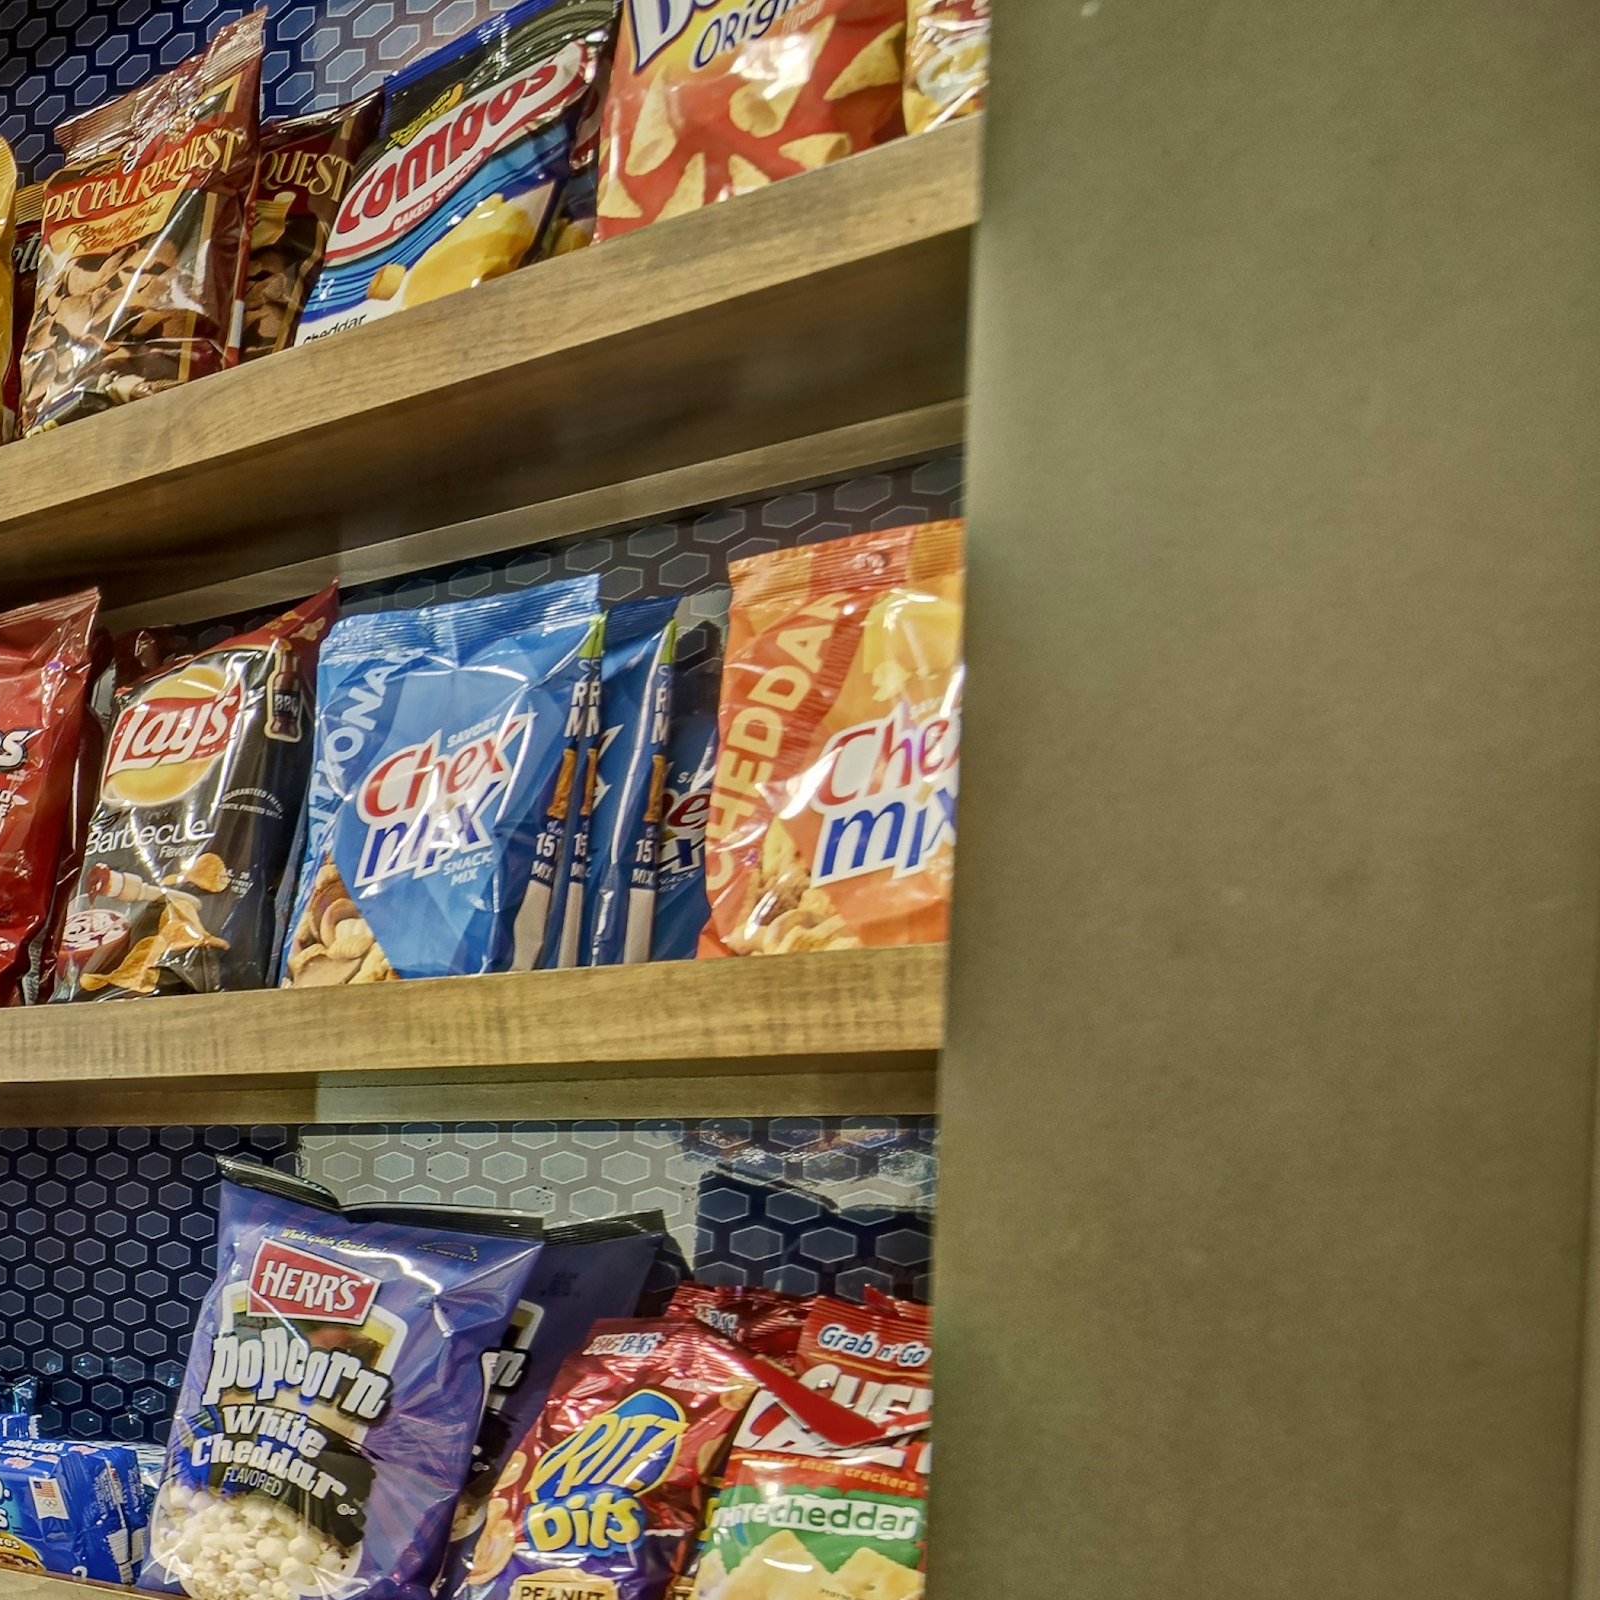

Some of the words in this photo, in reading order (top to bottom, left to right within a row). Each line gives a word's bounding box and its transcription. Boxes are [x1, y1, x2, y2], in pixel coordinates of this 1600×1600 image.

[43, 174, 136, 224] PECIAL
[134, 127, 247, 202] REQUEST
[260, 148, 352, 204] QUEST
[336, 63, 559, 235] Combos
[392, 197, 434, 231] BAKED
[434, 153, 487, 205] SNACKS
[107, 691, 240, 777] Lay's
[361, 716, 530, 821] Chex
[86, 819, 216, 856] Barbecue
[443, 851, 493, 877] SNACK
[451, 866, 478, 886] MIX
[259, 1261, 363, 1313] HERR'S
[817, 1324, 872, 1354] Grab
[899, 1343, 930, 1365] Go
[202, 1327, 391, 1420] popcorn
[222, 1406, 327, 1458] White
[524, 1412, 689, 1497] RITZ
[190, 1431, 348, 1500] Cheddar
[223, 1466, 283, 1498] FLAVORED
[845, 1465, 918, 1492] crackers
[526, 1492, 641, 1552] bits
[770, 1499, 918, 1535] cheddar
